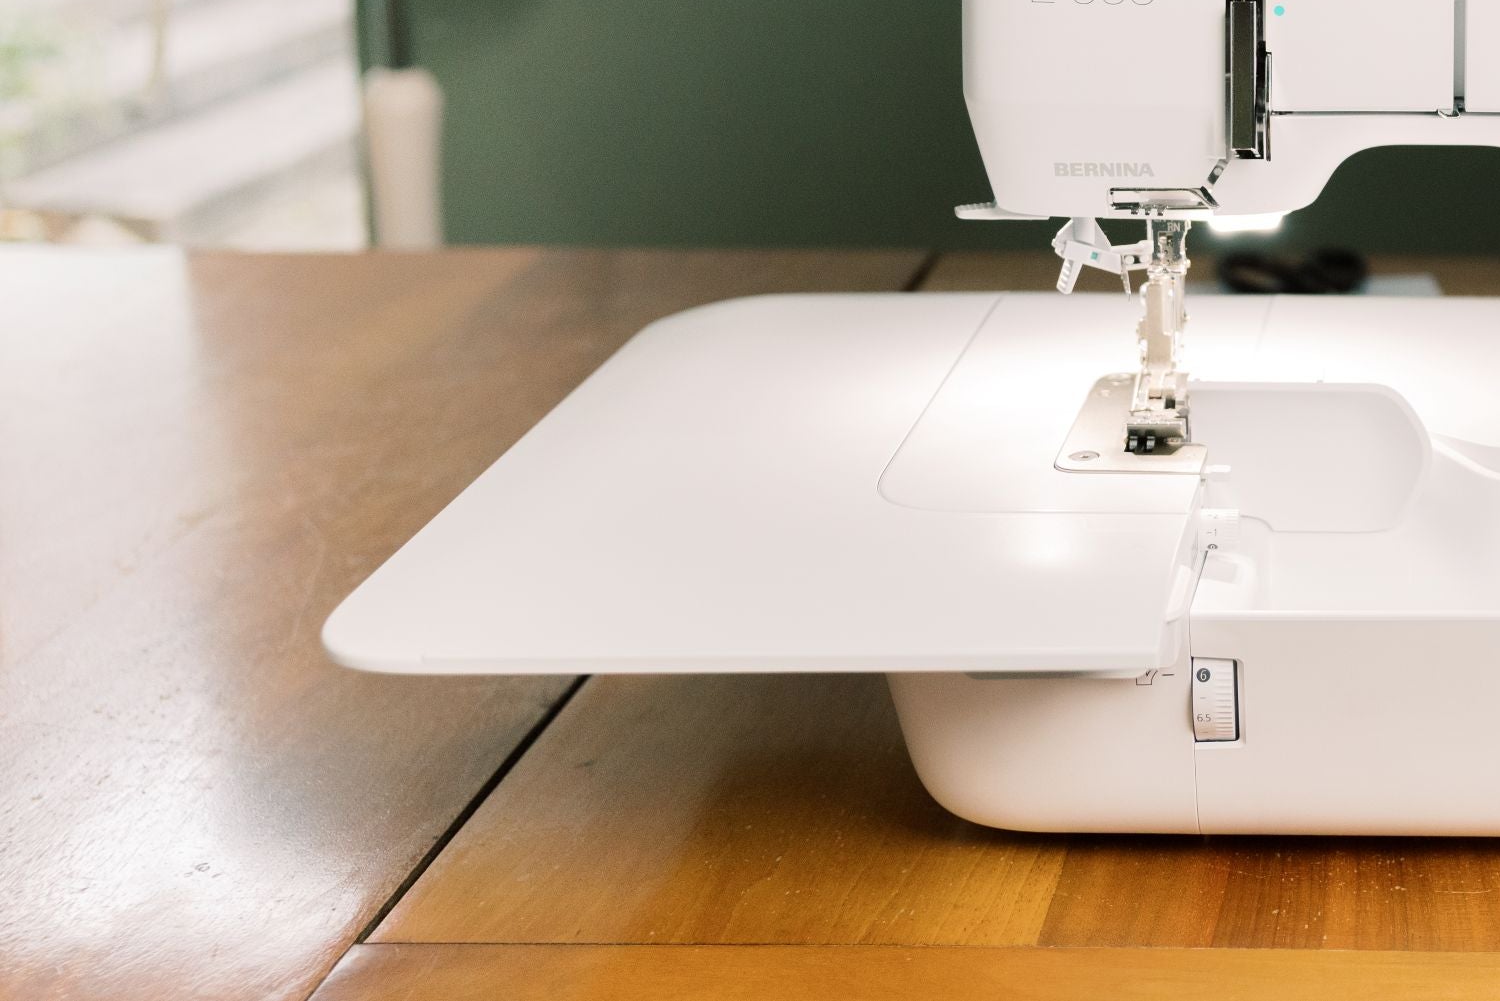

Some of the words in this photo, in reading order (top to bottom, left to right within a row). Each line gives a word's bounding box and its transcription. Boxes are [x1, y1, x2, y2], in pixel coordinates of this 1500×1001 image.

[1054, 162, 1155, 177] BERNINA
[1167, 222, 1181, 232] RN
[1198, 669, 1208, 681] 6
[1196, 713, 1212, 722] 6.5
